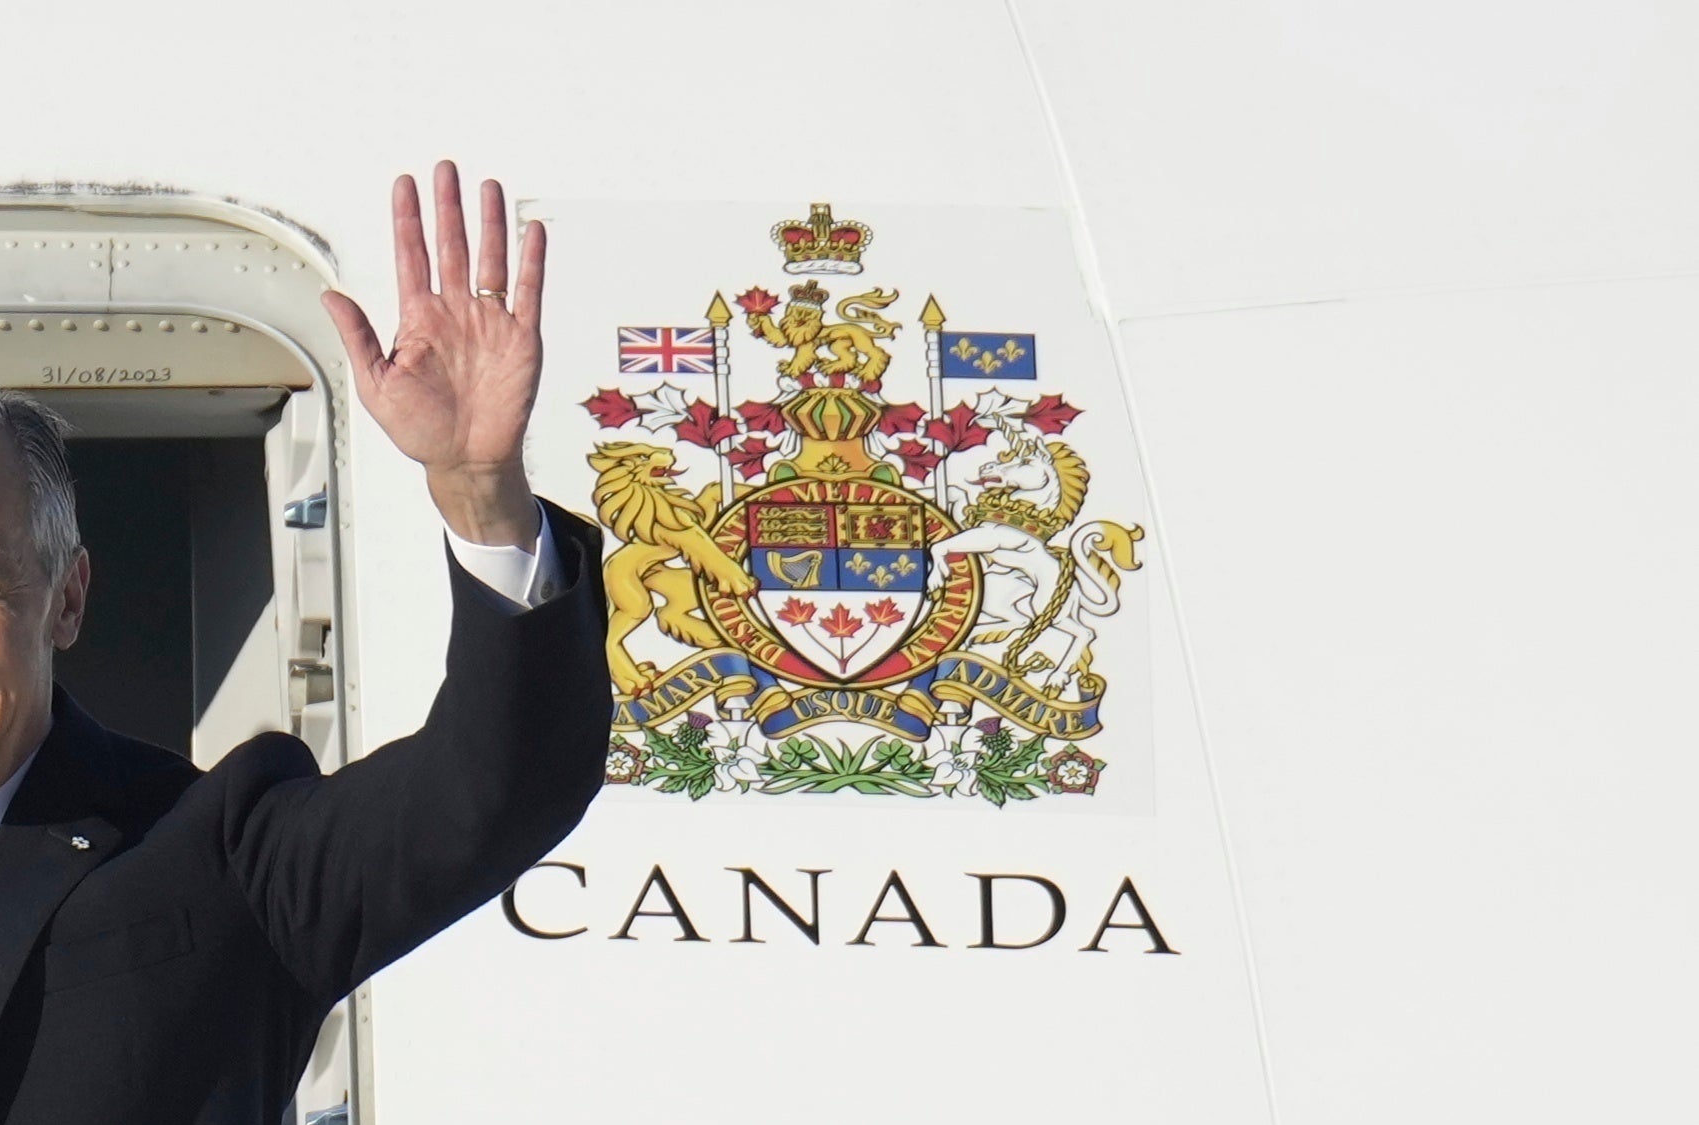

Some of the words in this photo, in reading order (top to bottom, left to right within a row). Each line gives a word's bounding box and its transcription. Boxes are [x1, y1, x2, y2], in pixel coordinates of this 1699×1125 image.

[42, 366, 171, 384] 31/08/2023
[902, 561, 972, 667] PATRIAM
[638, 658, 723, 719] MARI
[791, 690, 898, 722] USQUE
[948, 660, 998, 691] AD
[994, 685, 1084, 738] MARE
[501, 861, 1182, 956] CANADA
